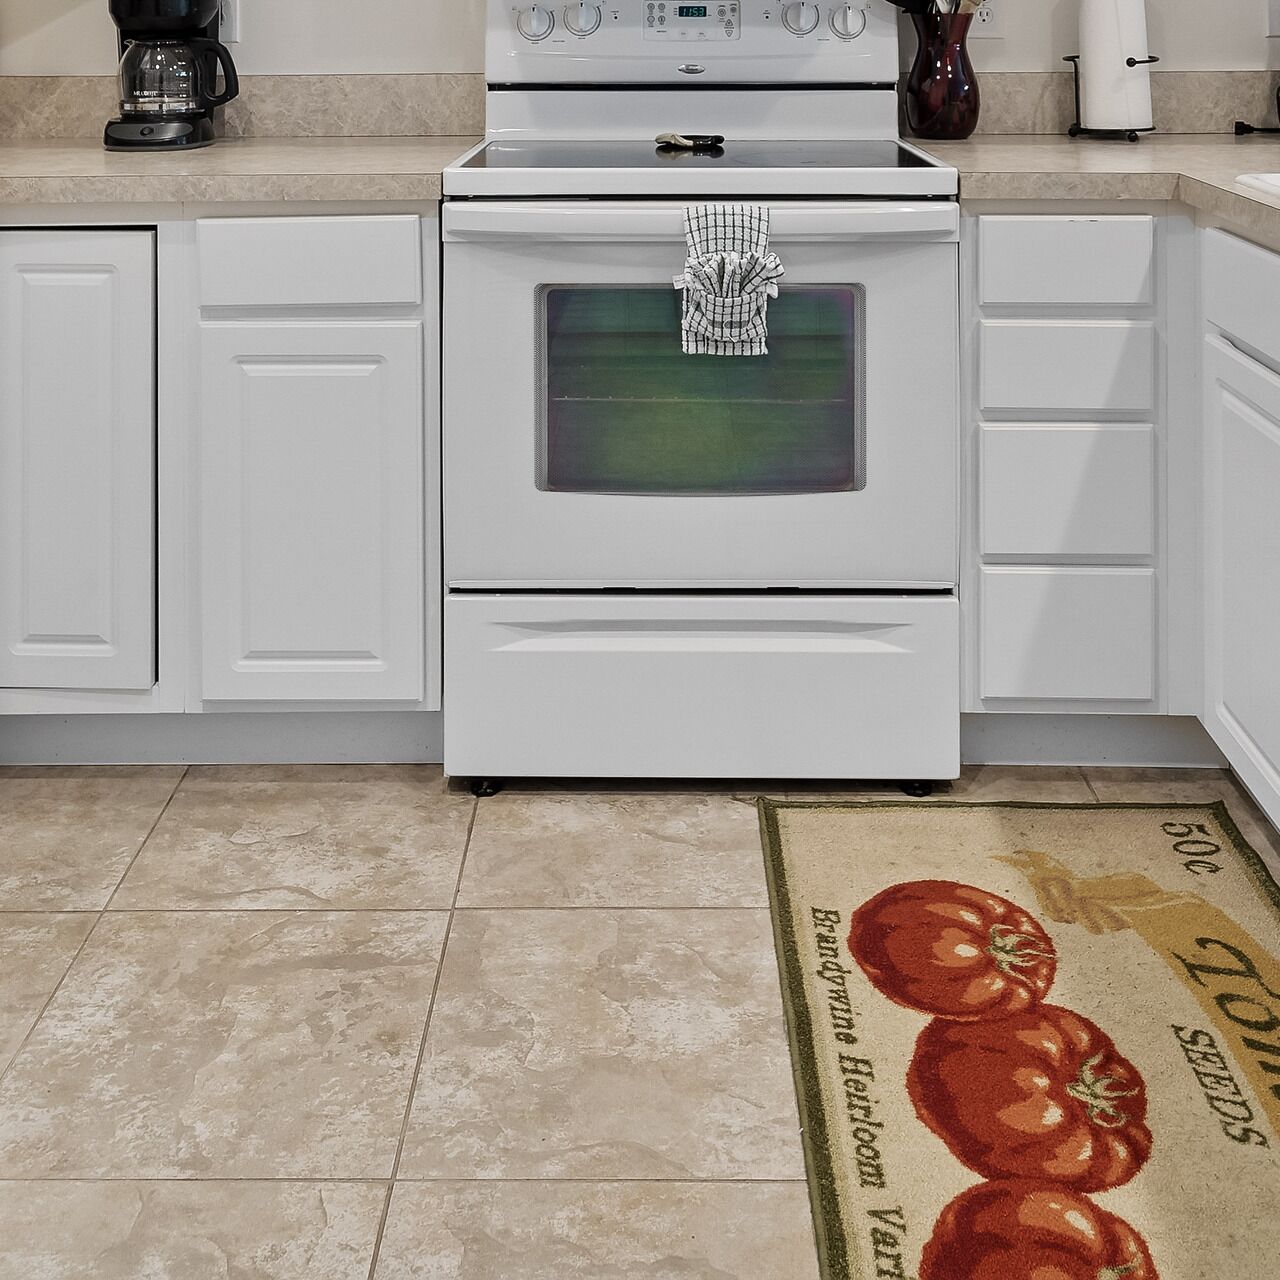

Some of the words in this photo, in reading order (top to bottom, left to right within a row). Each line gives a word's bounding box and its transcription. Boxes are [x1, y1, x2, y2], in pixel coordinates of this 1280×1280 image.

[811, 905, 859, 1046] Brandywine
[839, 1051, 887, 1190] Heirloom
[1171, 1022, 1270, 1150] SEEDS
